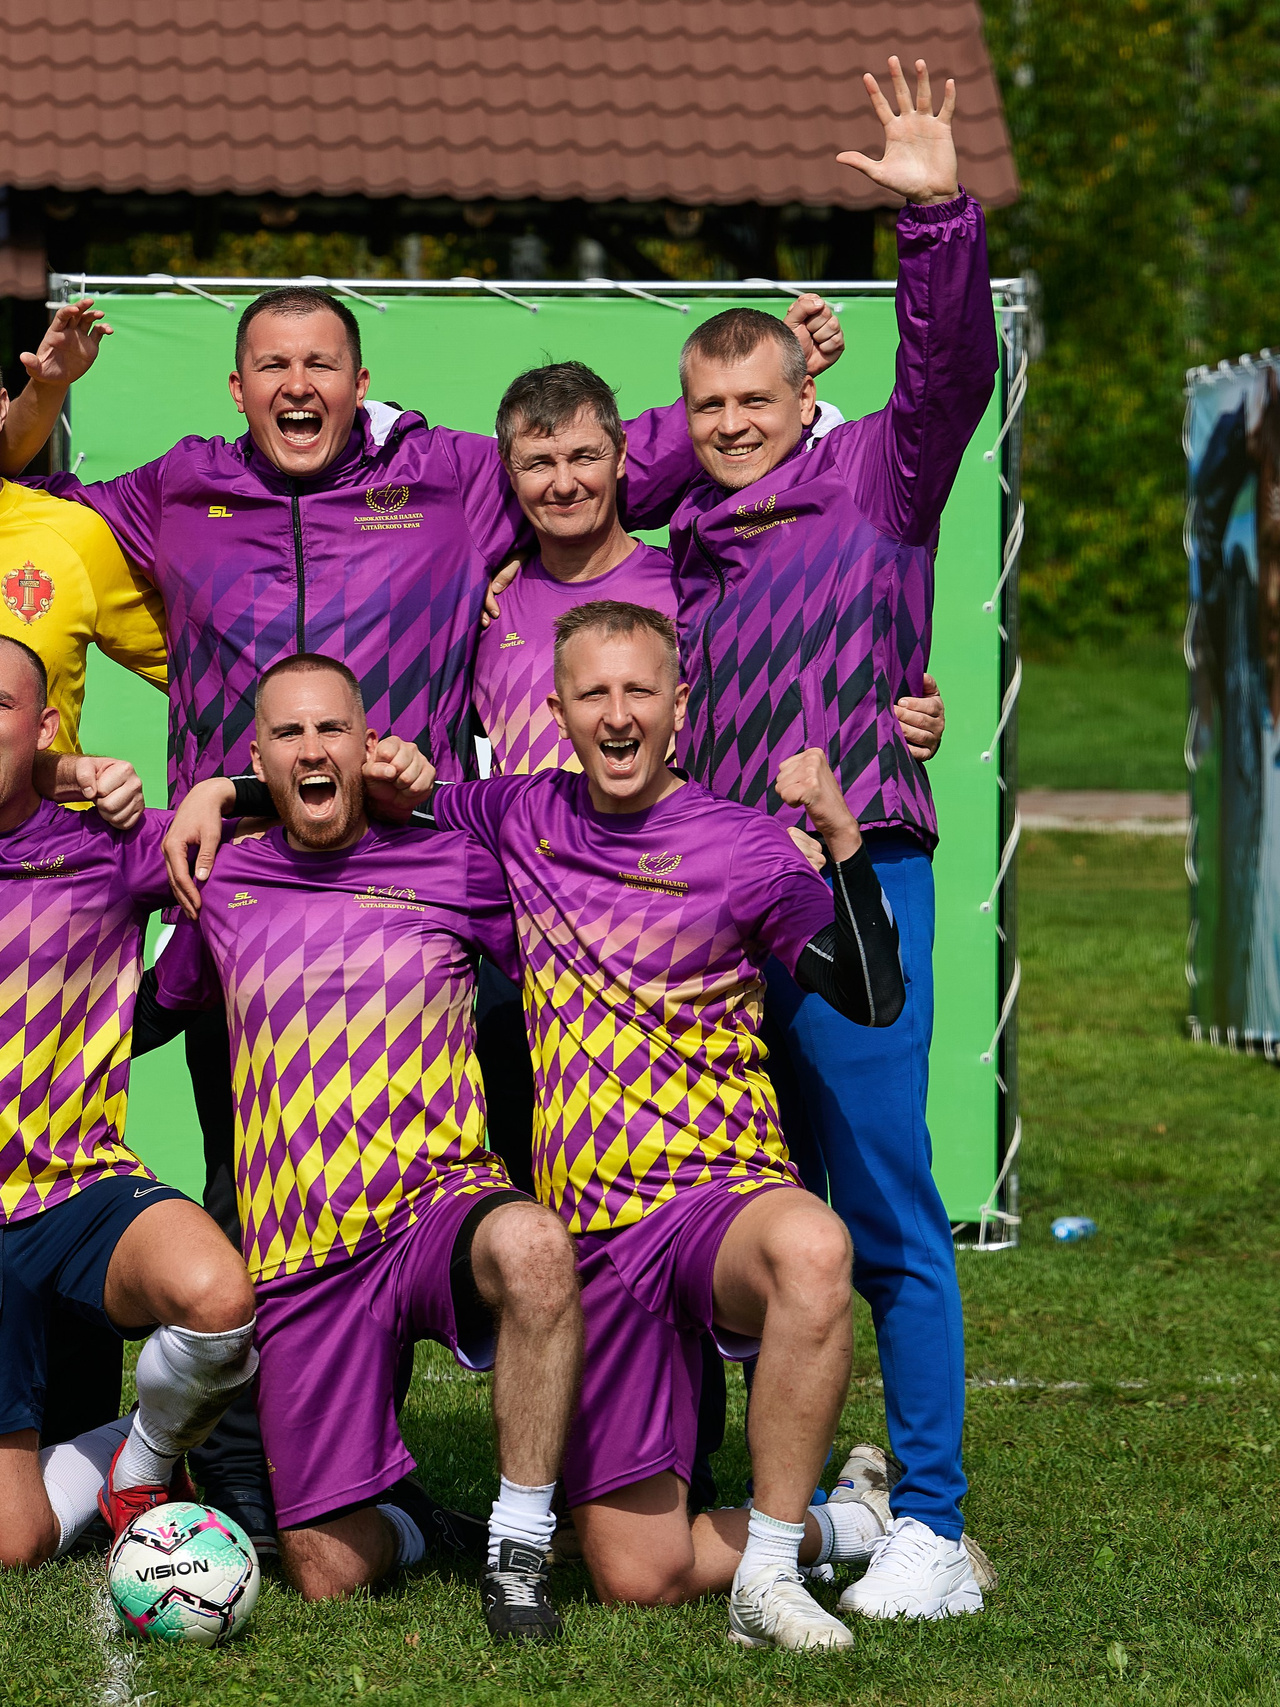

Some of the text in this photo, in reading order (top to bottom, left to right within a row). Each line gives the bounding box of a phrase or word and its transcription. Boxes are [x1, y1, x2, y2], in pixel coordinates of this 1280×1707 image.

[207, 505, 233, 518] SL
[234, 892, 252, 901] SL
[665, 890, 683, 898] КРАЯ
[228, 898, 258, 909] SportLife
[359, 902, 405, 910] АЛТАЙСКОГО
[135, 1559, 210, 1583] VISION
